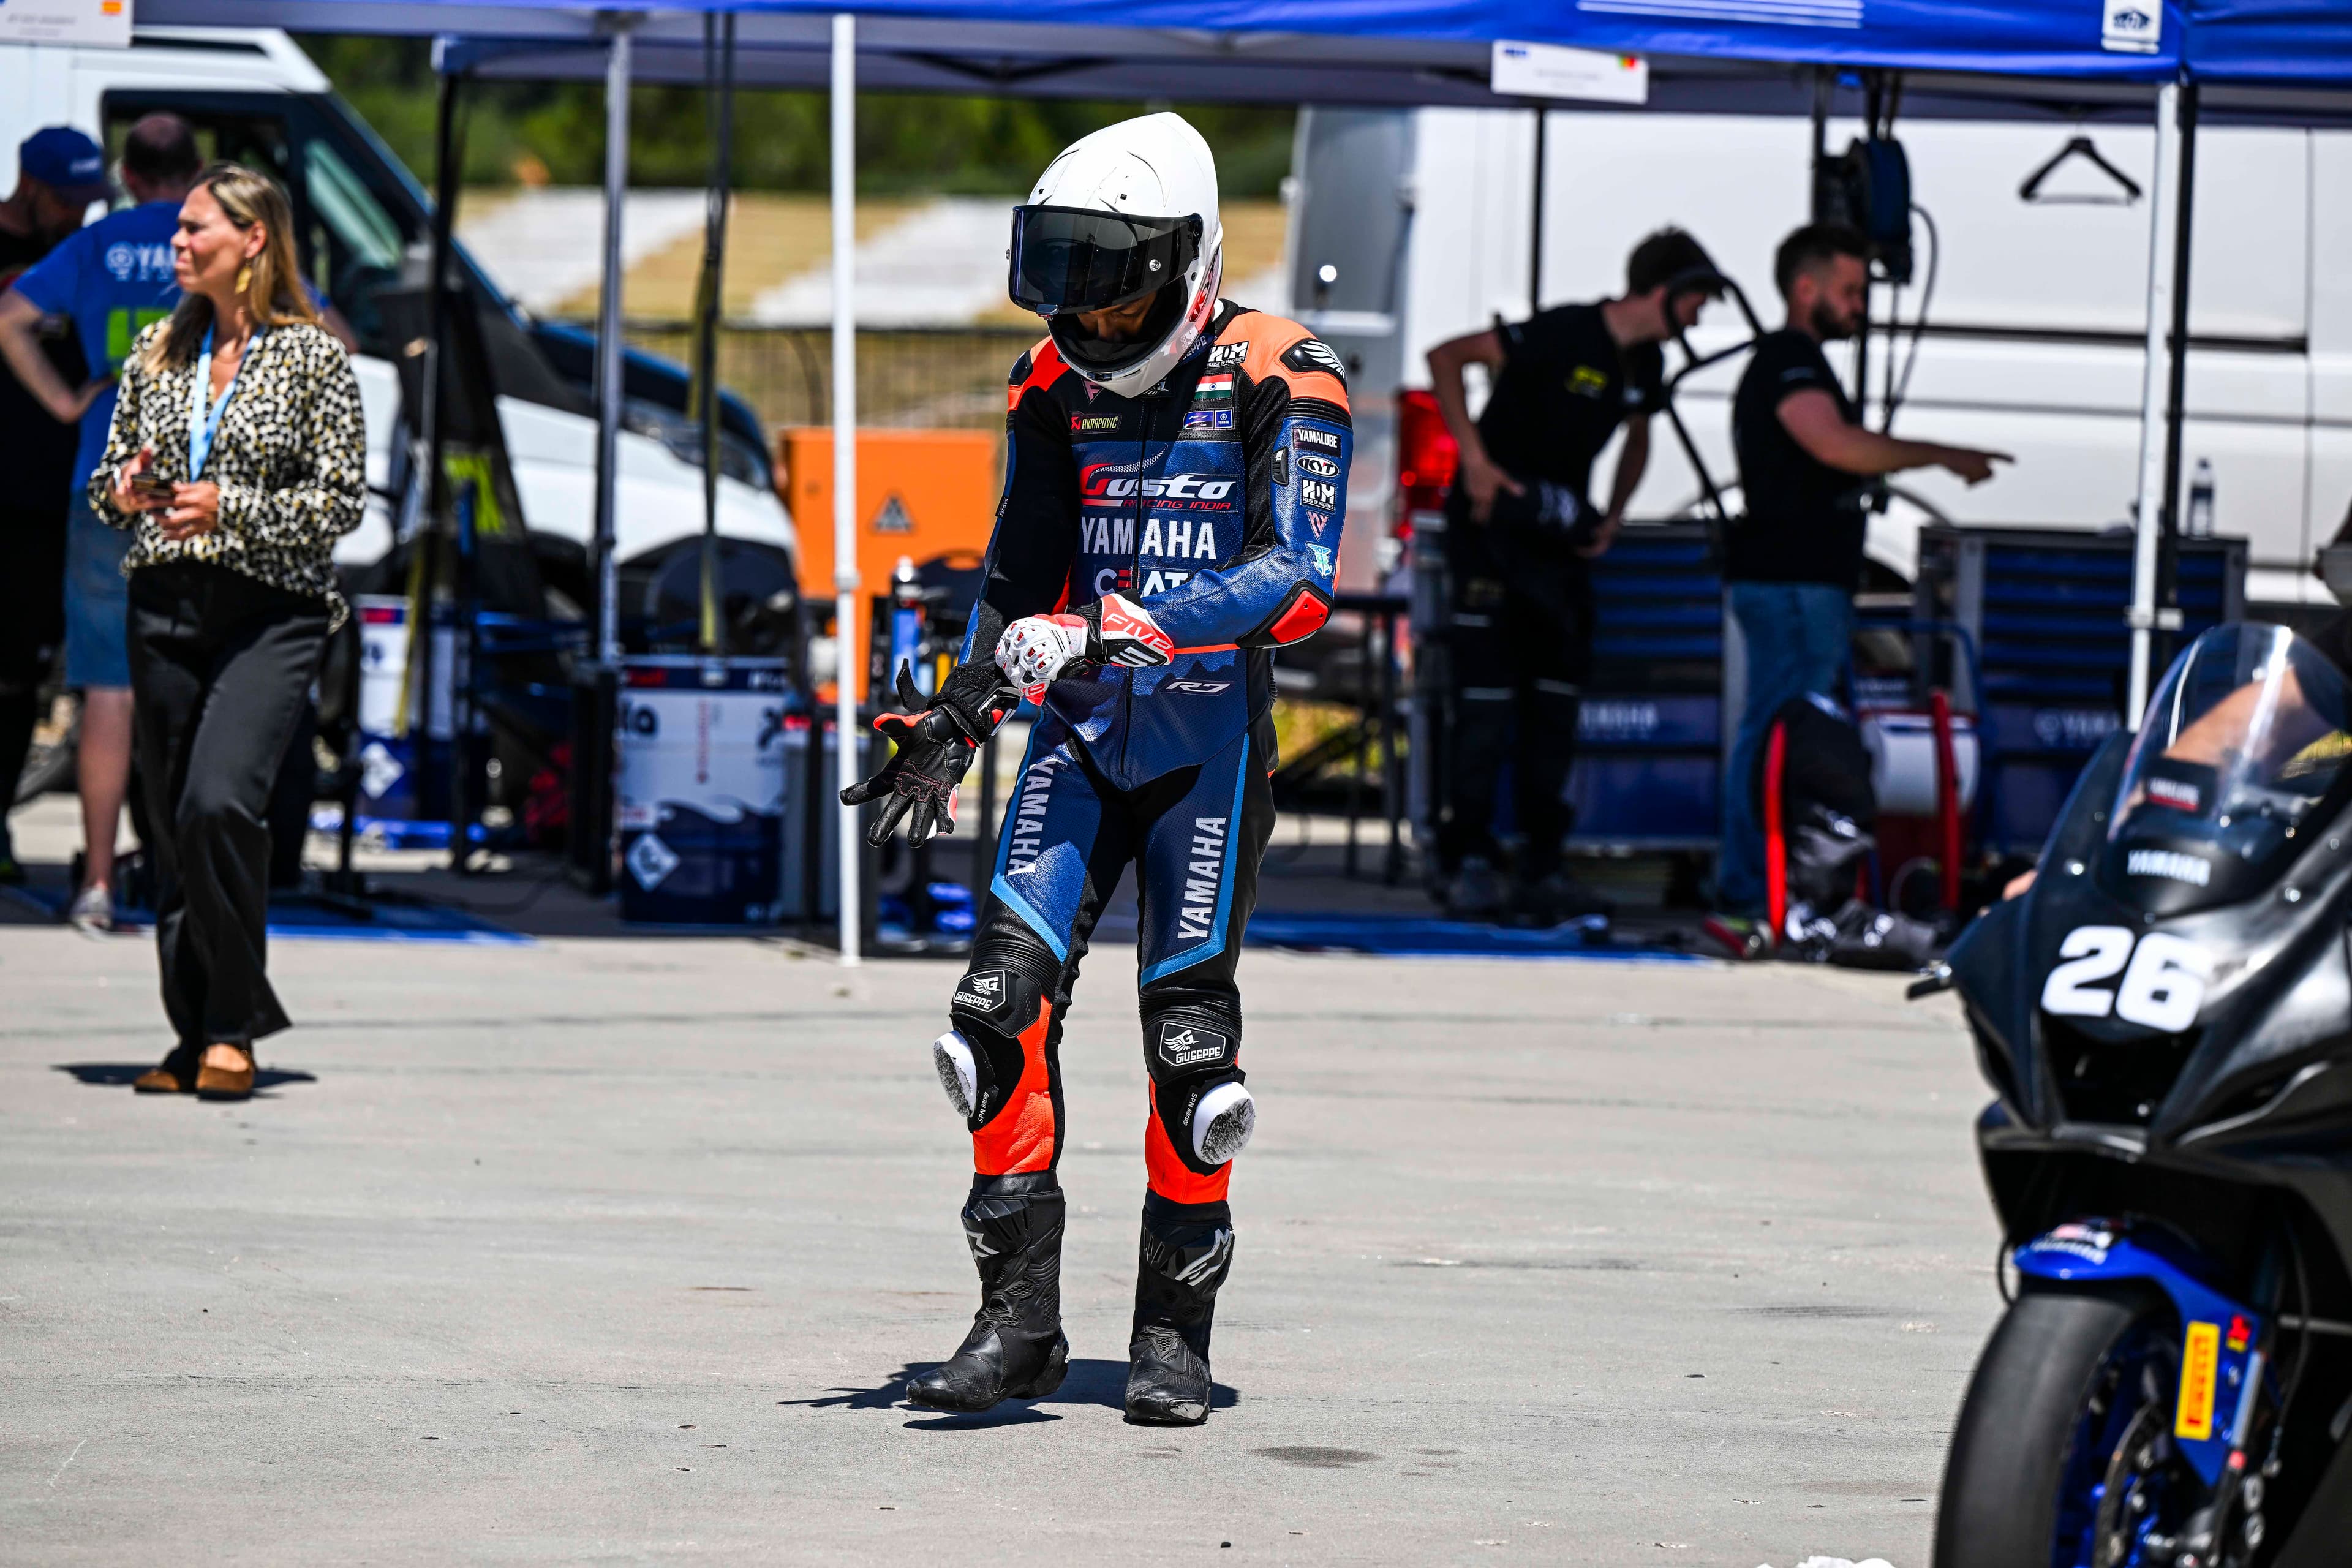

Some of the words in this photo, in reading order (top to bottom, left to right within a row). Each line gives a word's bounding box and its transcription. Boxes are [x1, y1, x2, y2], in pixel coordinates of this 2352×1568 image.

[1298, 429, 1338, 448] YAMALUBE
[1305, 459, 1334, 474] KYT
[1189, 501, 1231, 510] INDIA
[1081, 516, 1216, 560] YAMAHA
[1166, 682, 1231, 693] R7
[1177, 817, 1226, 939] YAMAHA
[2040, 925, 2209, 1033] 26
[1188, 1093, 1197, 1108] SPN
